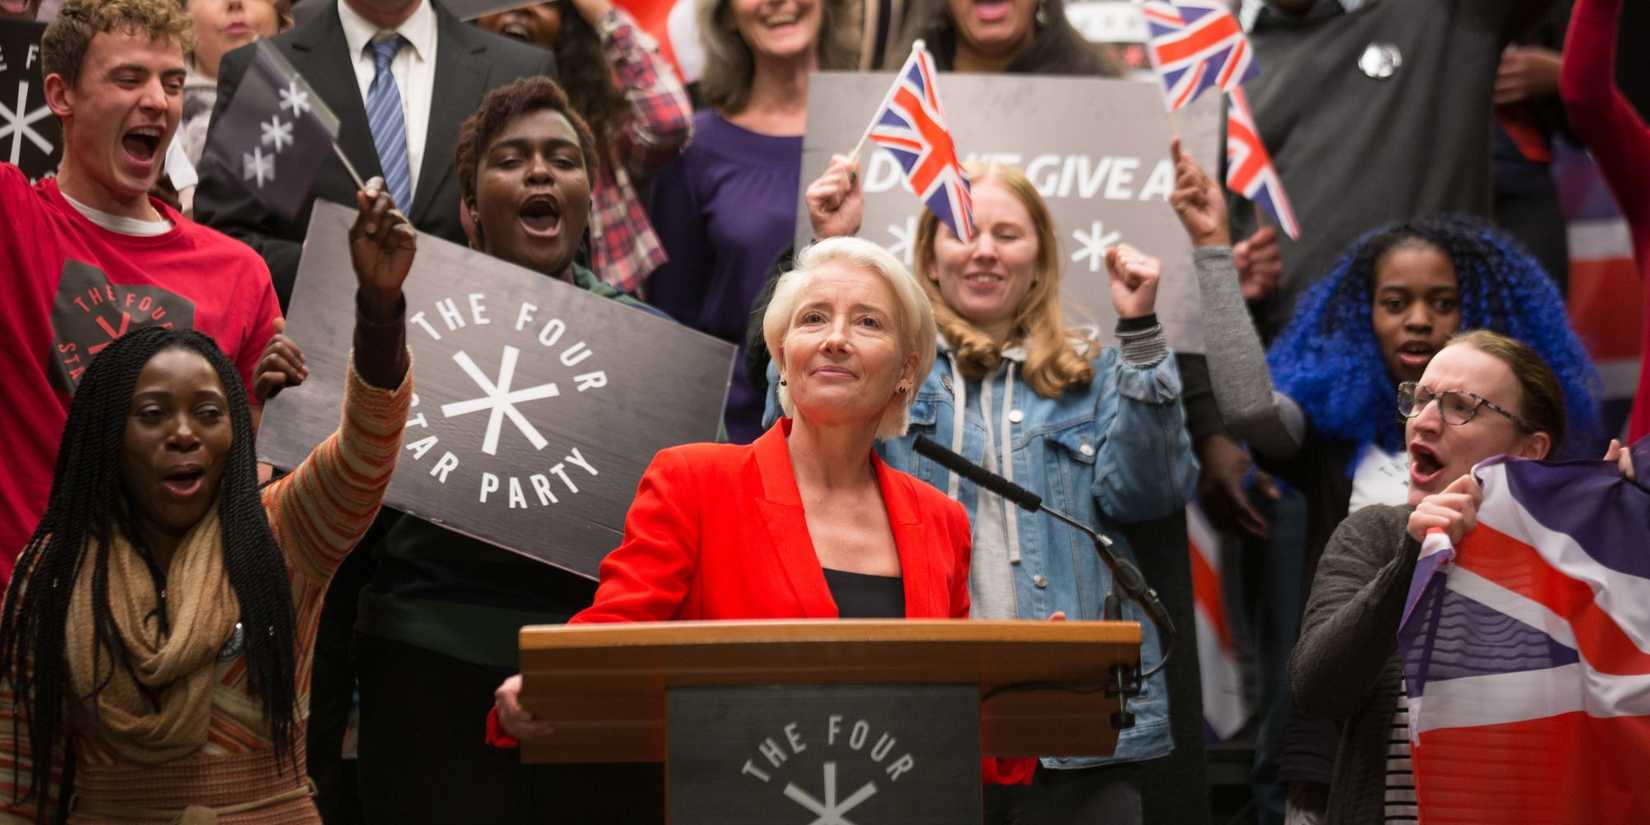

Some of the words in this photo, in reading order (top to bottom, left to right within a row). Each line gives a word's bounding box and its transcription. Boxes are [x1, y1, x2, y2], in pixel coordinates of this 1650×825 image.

[1025, 154, 1140, 200] GIVE
[1139, 159, 1176, 201] A
[73, 284, 116, 313] THE
[57, 342, 87, 380] STA
[410, 293, 491, 340] THE
[515, 302, 608, 392] FOUR
[479, 447, 599, 509] PARTY
[741, 722, 807, 782] THE
[828, 715, 914, 781] FOUR
